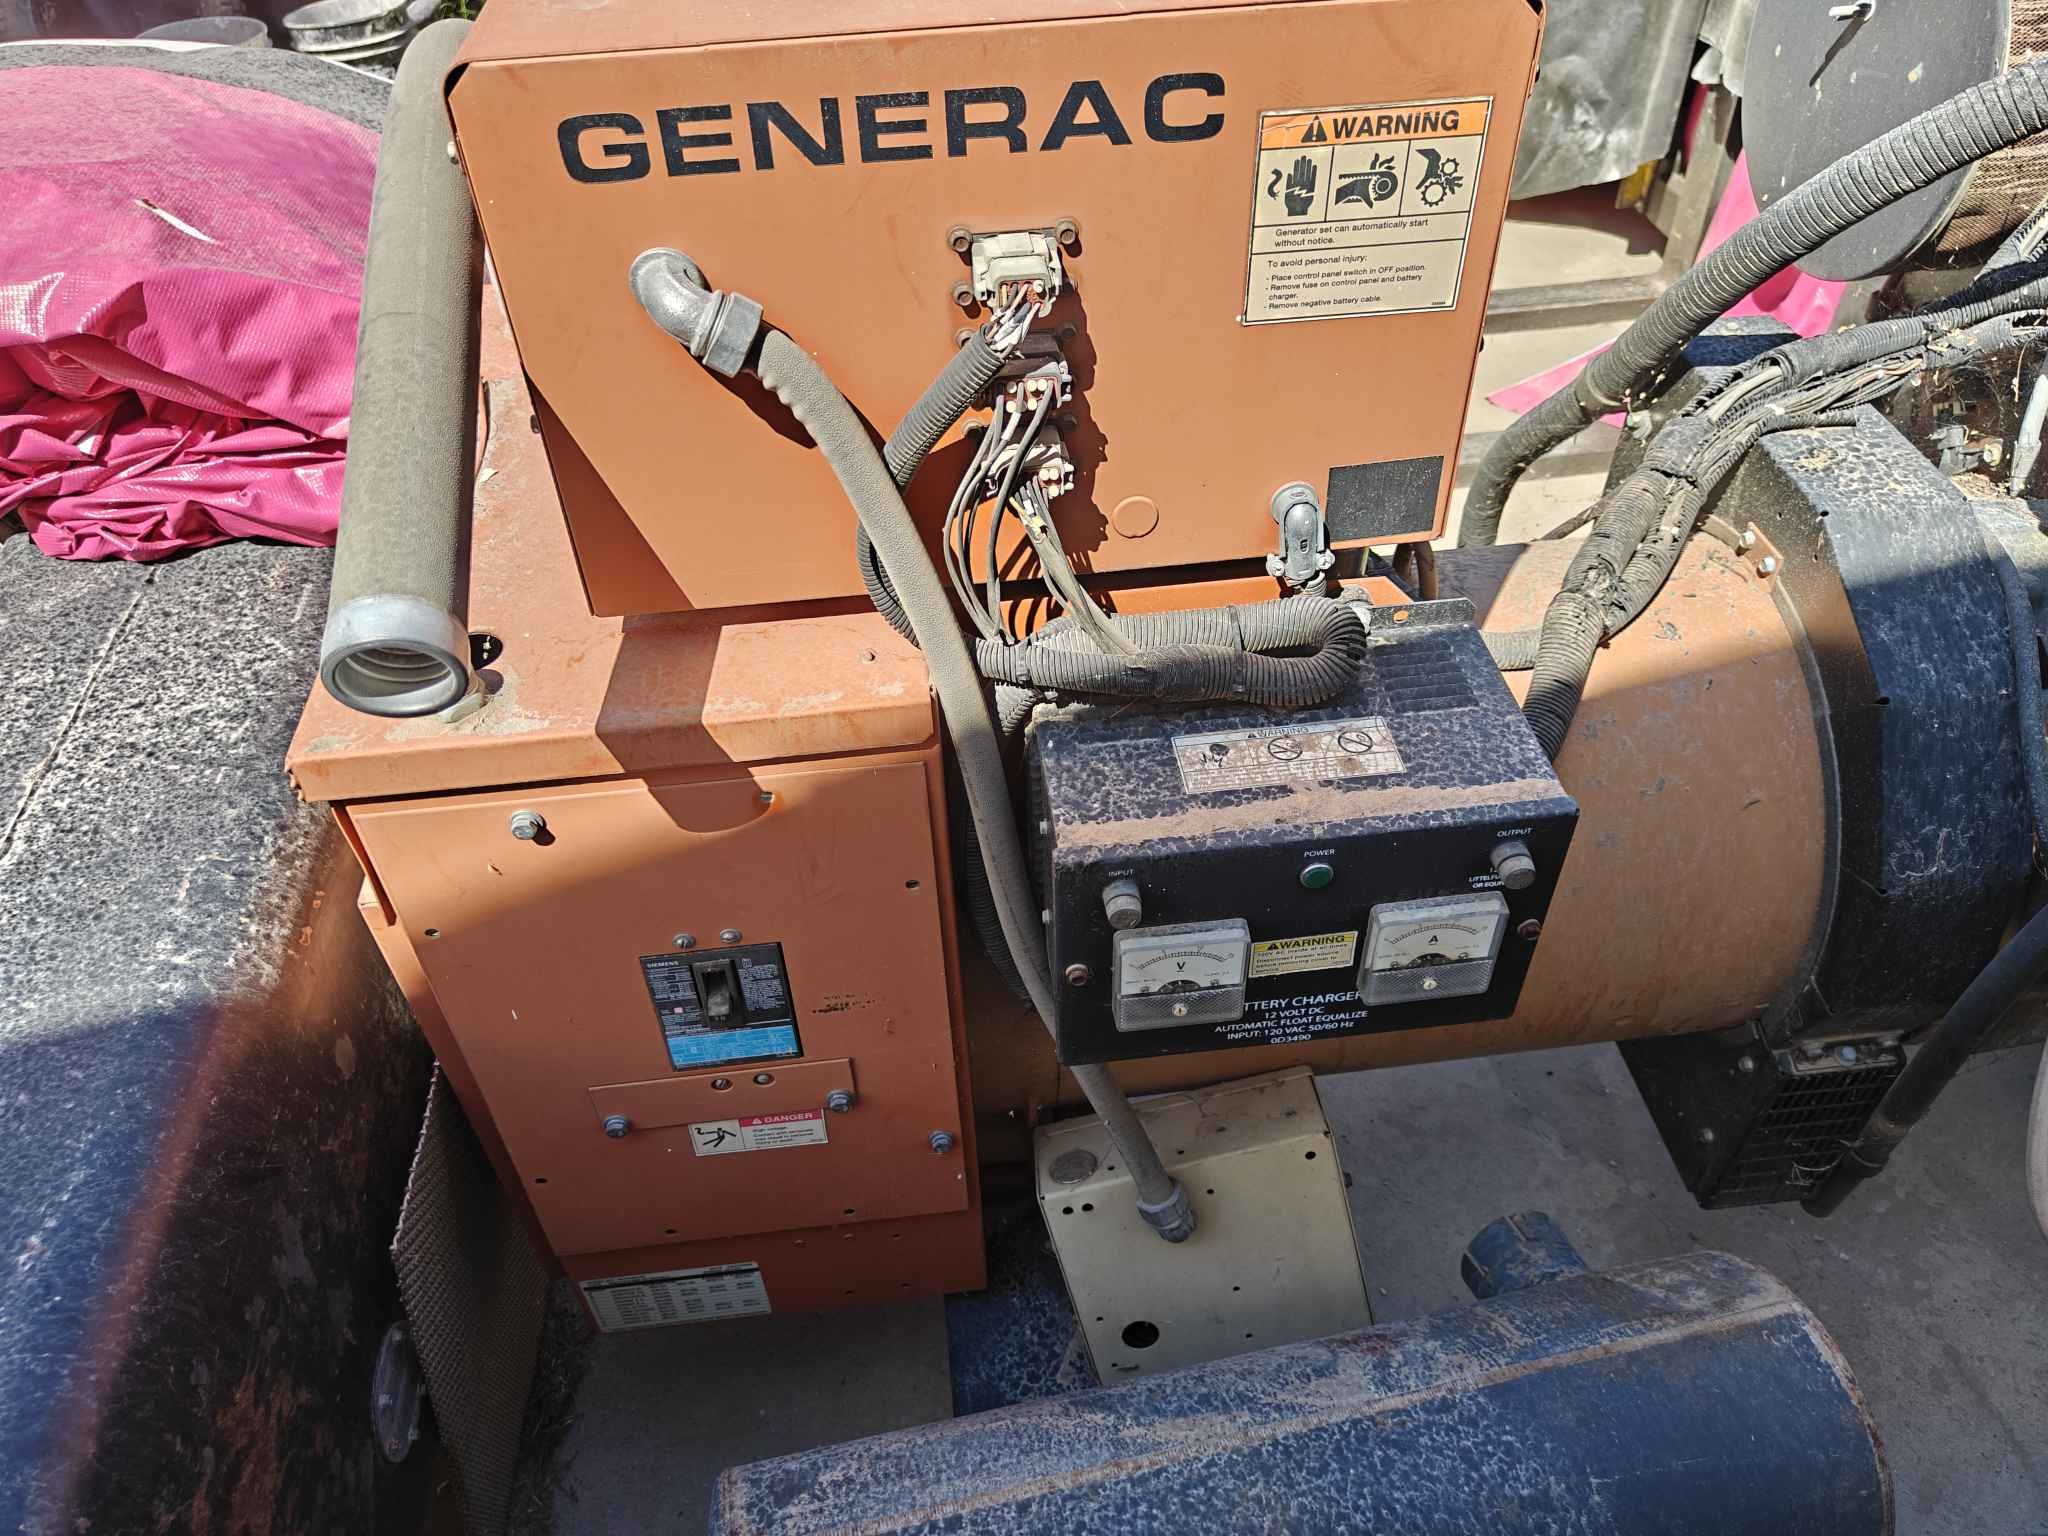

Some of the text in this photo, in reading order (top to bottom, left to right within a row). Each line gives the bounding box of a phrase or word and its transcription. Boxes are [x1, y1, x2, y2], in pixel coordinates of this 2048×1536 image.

[557, 72, 1225, 184] GENERAC
[1332, 110, 1460, 139] WARNING
[1275, 219, 1429, 237] Generator set can automatically start
[1274, 236, 1335, 248] without notice.
[1268, 254, 1368, 268] To avoid personal injury:
[1271, 273, 1292, 282] Place
[1293, 271, 1320, 281] control
[1321, 269, 1342, 279] panel
[1343, 268, 1368, 277] switch
[1369, 267, 1376, 275] in
[1378, 265, 1394, 274] OFF
[1270, 273, 1422, 292] Remove fuse on control panel and battery
[1268, 301, 1299, 310] Remove
[1300, 299, 1332, 309] negative
[1333, 297, 1361, 306] battery
[1496, 827, 1533, 838] OUTPUT
[1304, 848, 1336, 858] POWER
[1108, 868, 1135, 879] INPUT
[1468, 872, 1502, 883] LITTELFU
[1279, 935, 1345, 949] WARNING
[1428, 935, 1439, 944] A
[1176, 961, 1186, 970] V
[1244, 998, 1289, 1012] TTERY
[1265, 1006, 1325, 1019] 12 VOLT DC
[1214, 1010, 1369, 1033] AUTOMATIC FLOAT EQUALIZE
[1227, 1020, 1355, 1040] INPUT: 120 VAC 50/60 Hz
[764, 1112, 814, 1124] DANGER
